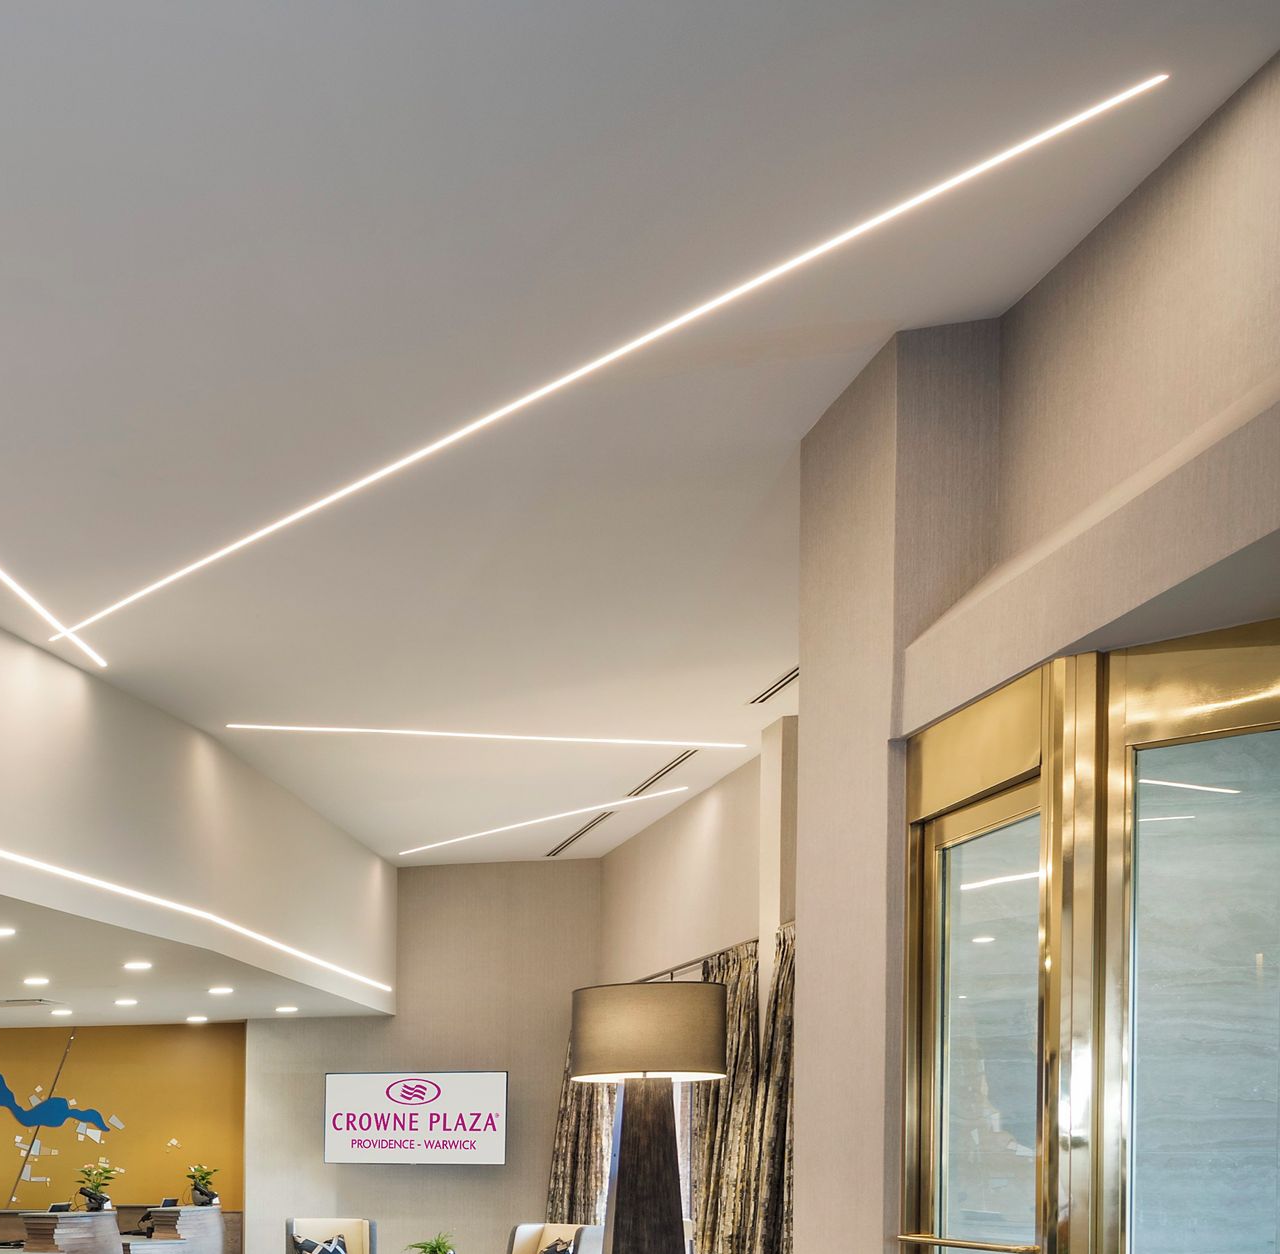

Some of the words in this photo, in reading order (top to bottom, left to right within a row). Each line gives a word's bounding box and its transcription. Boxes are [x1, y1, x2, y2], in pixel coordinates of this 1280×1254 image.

[331, 1112, 419, 1132] CROWNE
[351, 1138, 415, 1150] PROVIDENCE
[424, 1139, 477, 1150] WARWICK
